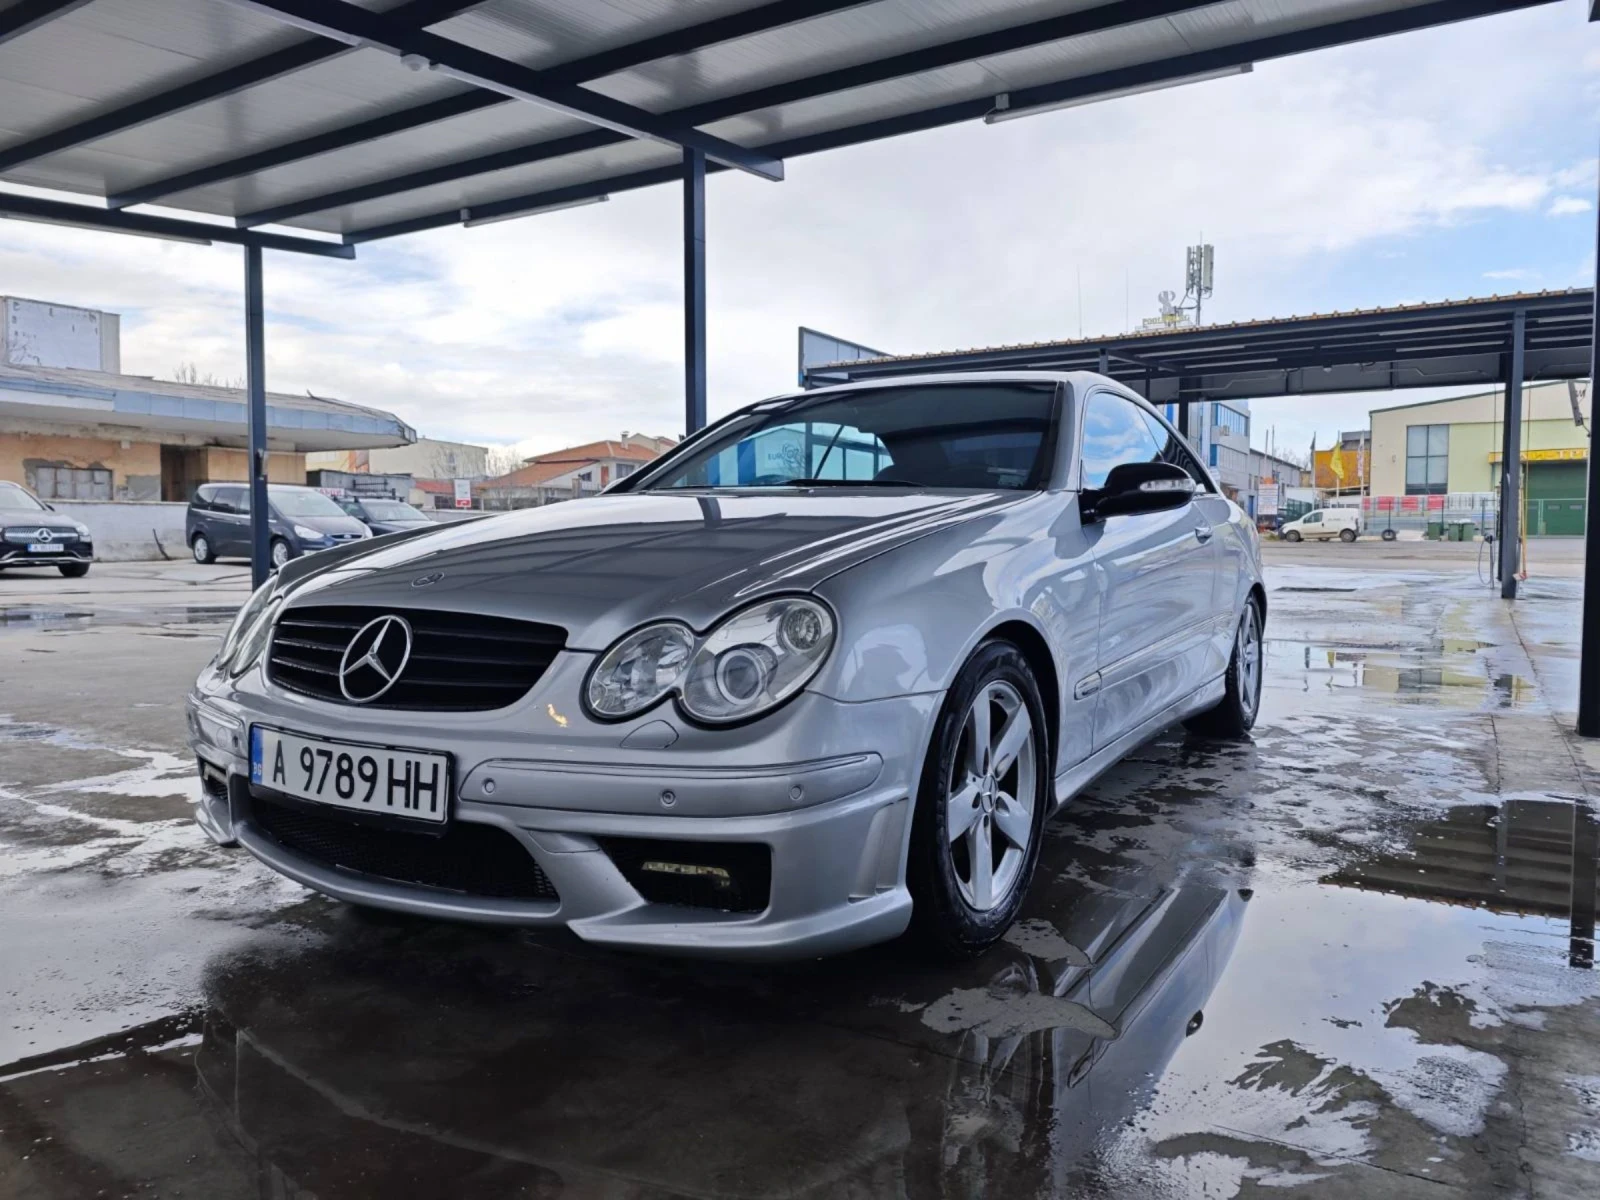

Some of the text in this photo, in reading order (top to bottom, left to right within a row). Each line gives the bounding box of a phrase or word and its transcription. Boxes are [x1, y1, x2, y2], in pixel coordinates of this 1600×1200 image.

[252, 762, 262, 776] BG
[273, 740, 439, 812] A 9789 HH
